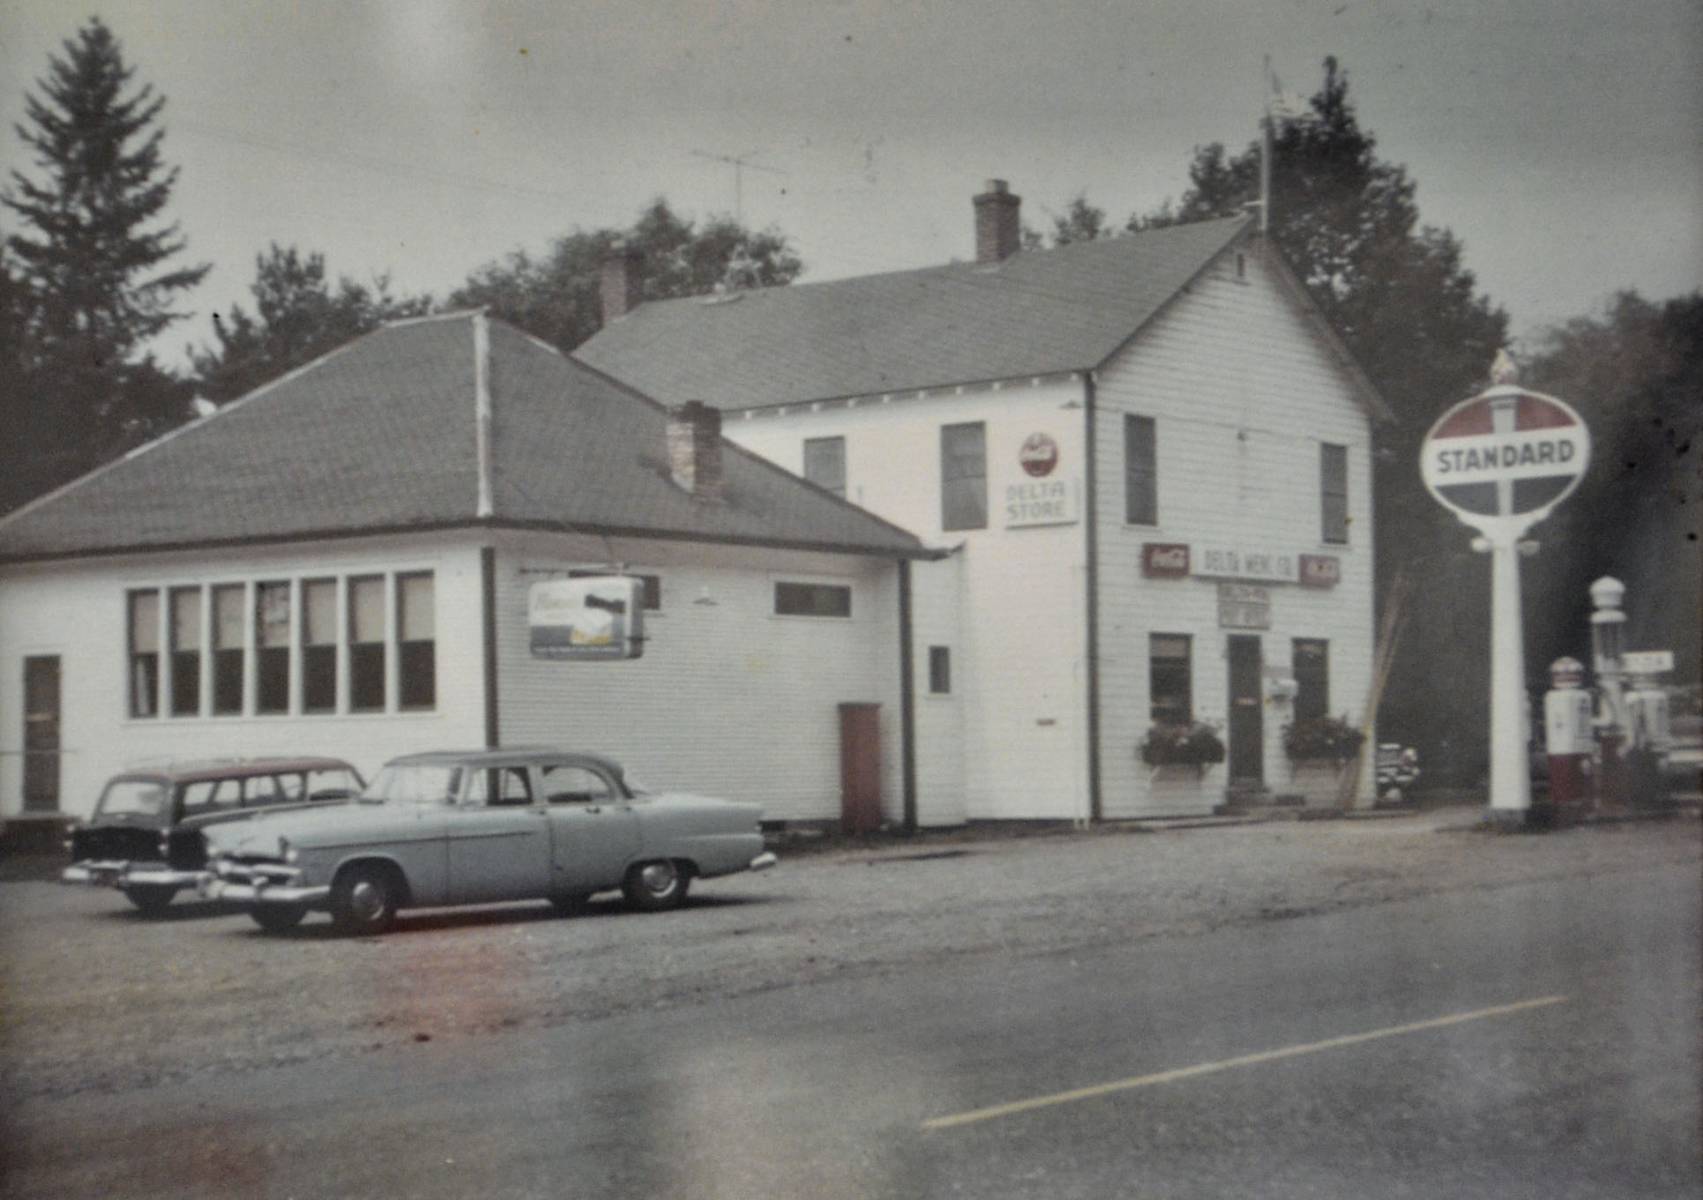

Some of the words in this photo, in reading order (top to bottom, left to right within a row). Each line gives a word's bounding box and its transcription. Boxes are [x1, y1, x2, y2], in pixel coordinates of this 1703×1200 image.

[1437, 439, 1575, 474] STANDARD
[1005, 480, 1065, 501] DELTA
[1006, 500, 1066, 521] STORE
